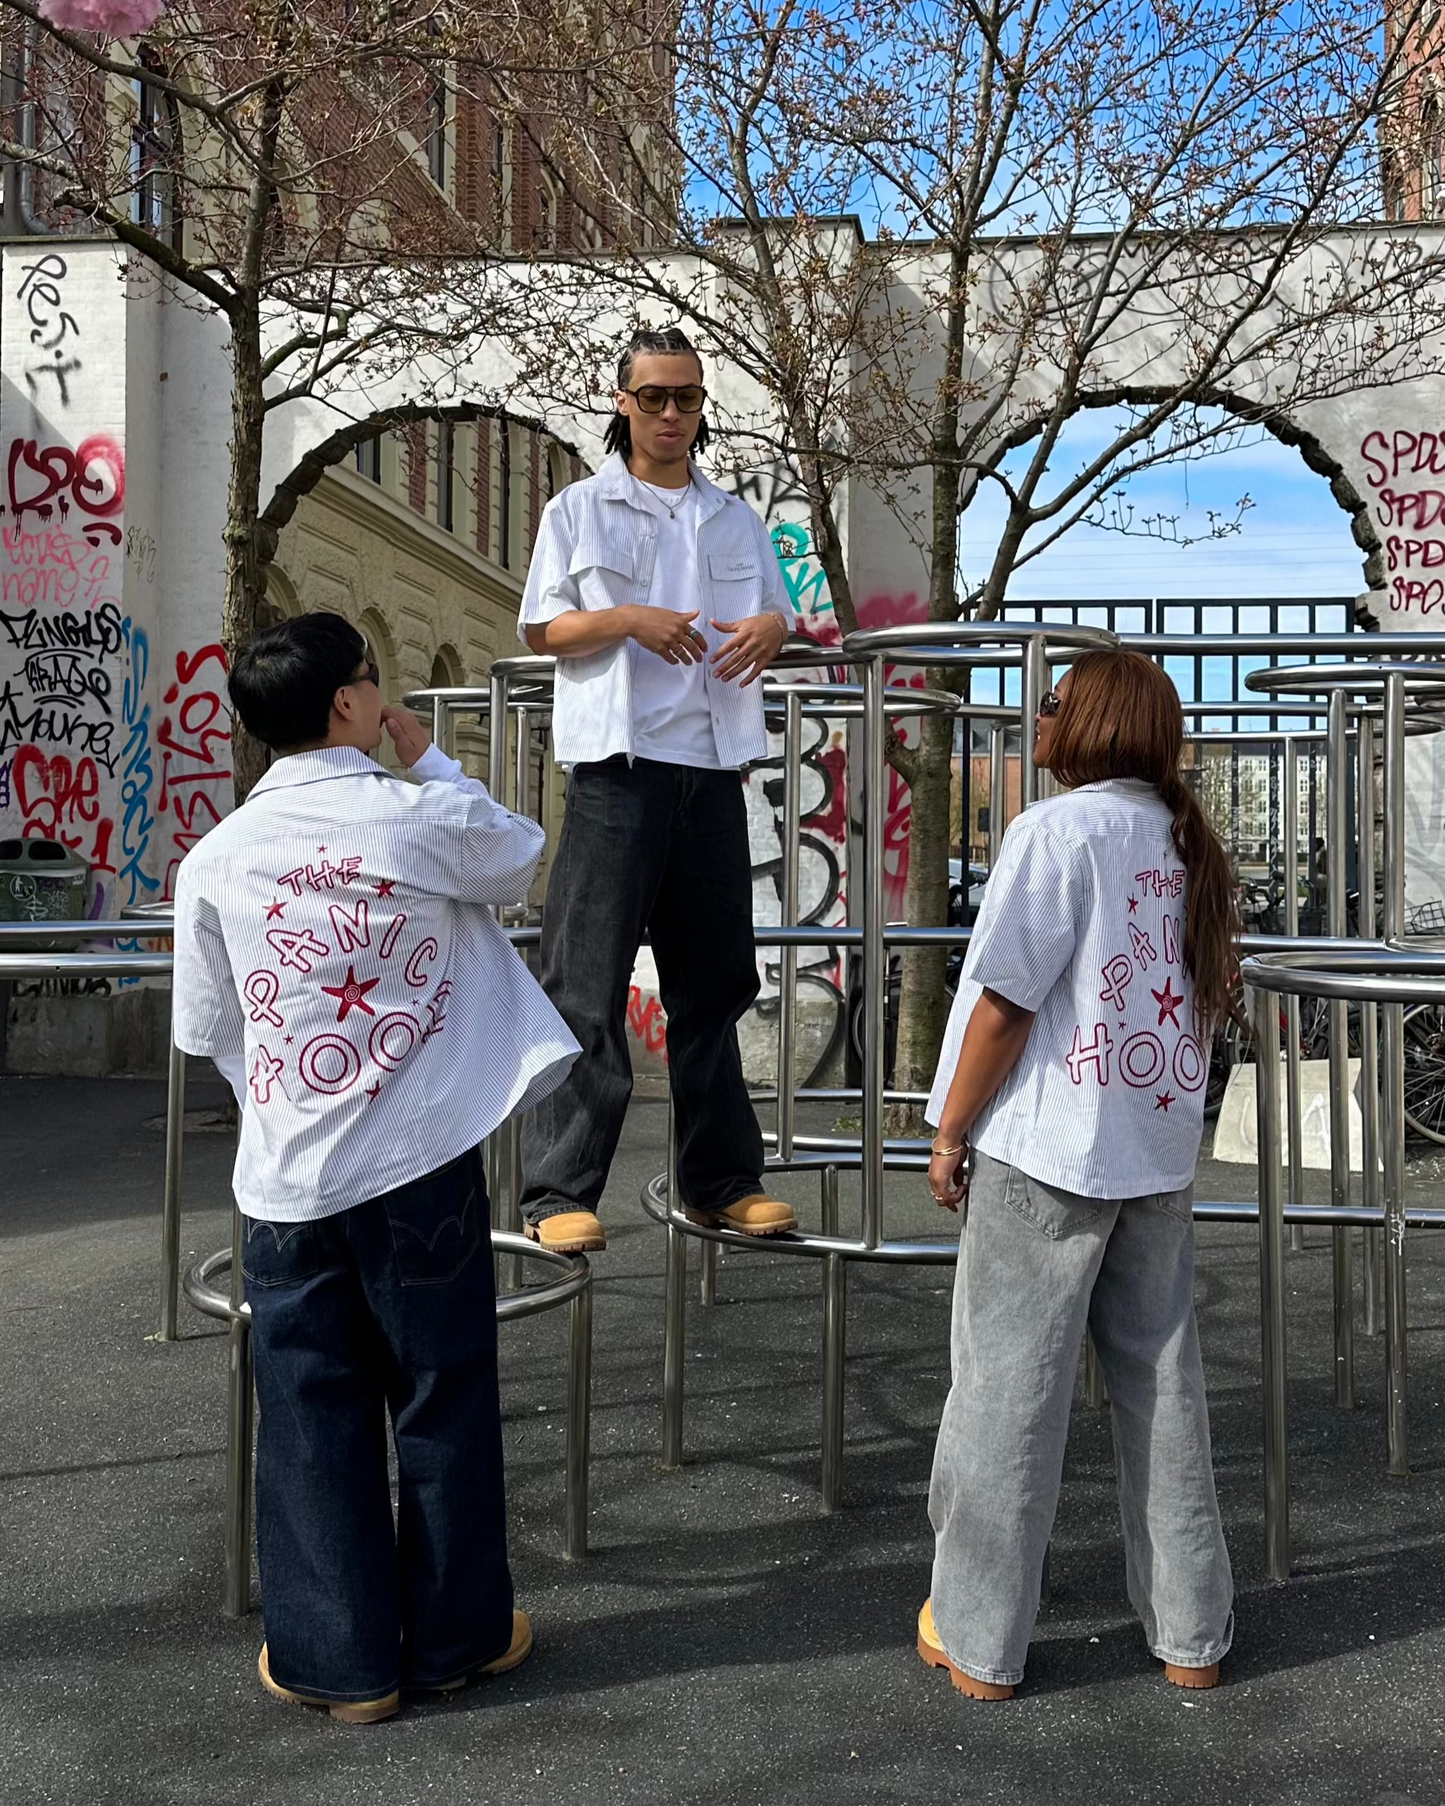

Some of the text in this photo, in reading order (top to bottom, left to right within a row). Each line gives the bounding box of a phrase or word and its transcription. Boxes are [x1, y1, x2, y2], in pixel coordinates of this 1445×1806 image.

[1377, 489, 1445, 532] SPD
[277, 856, 362, 896] THE
[1134, 869, 1185, 899] THE
[244, 899, 438, 1028] PANIC
[1100, 914, 1190, 1012] PAN
[1066, 1014, 1206, 1092] HOO
